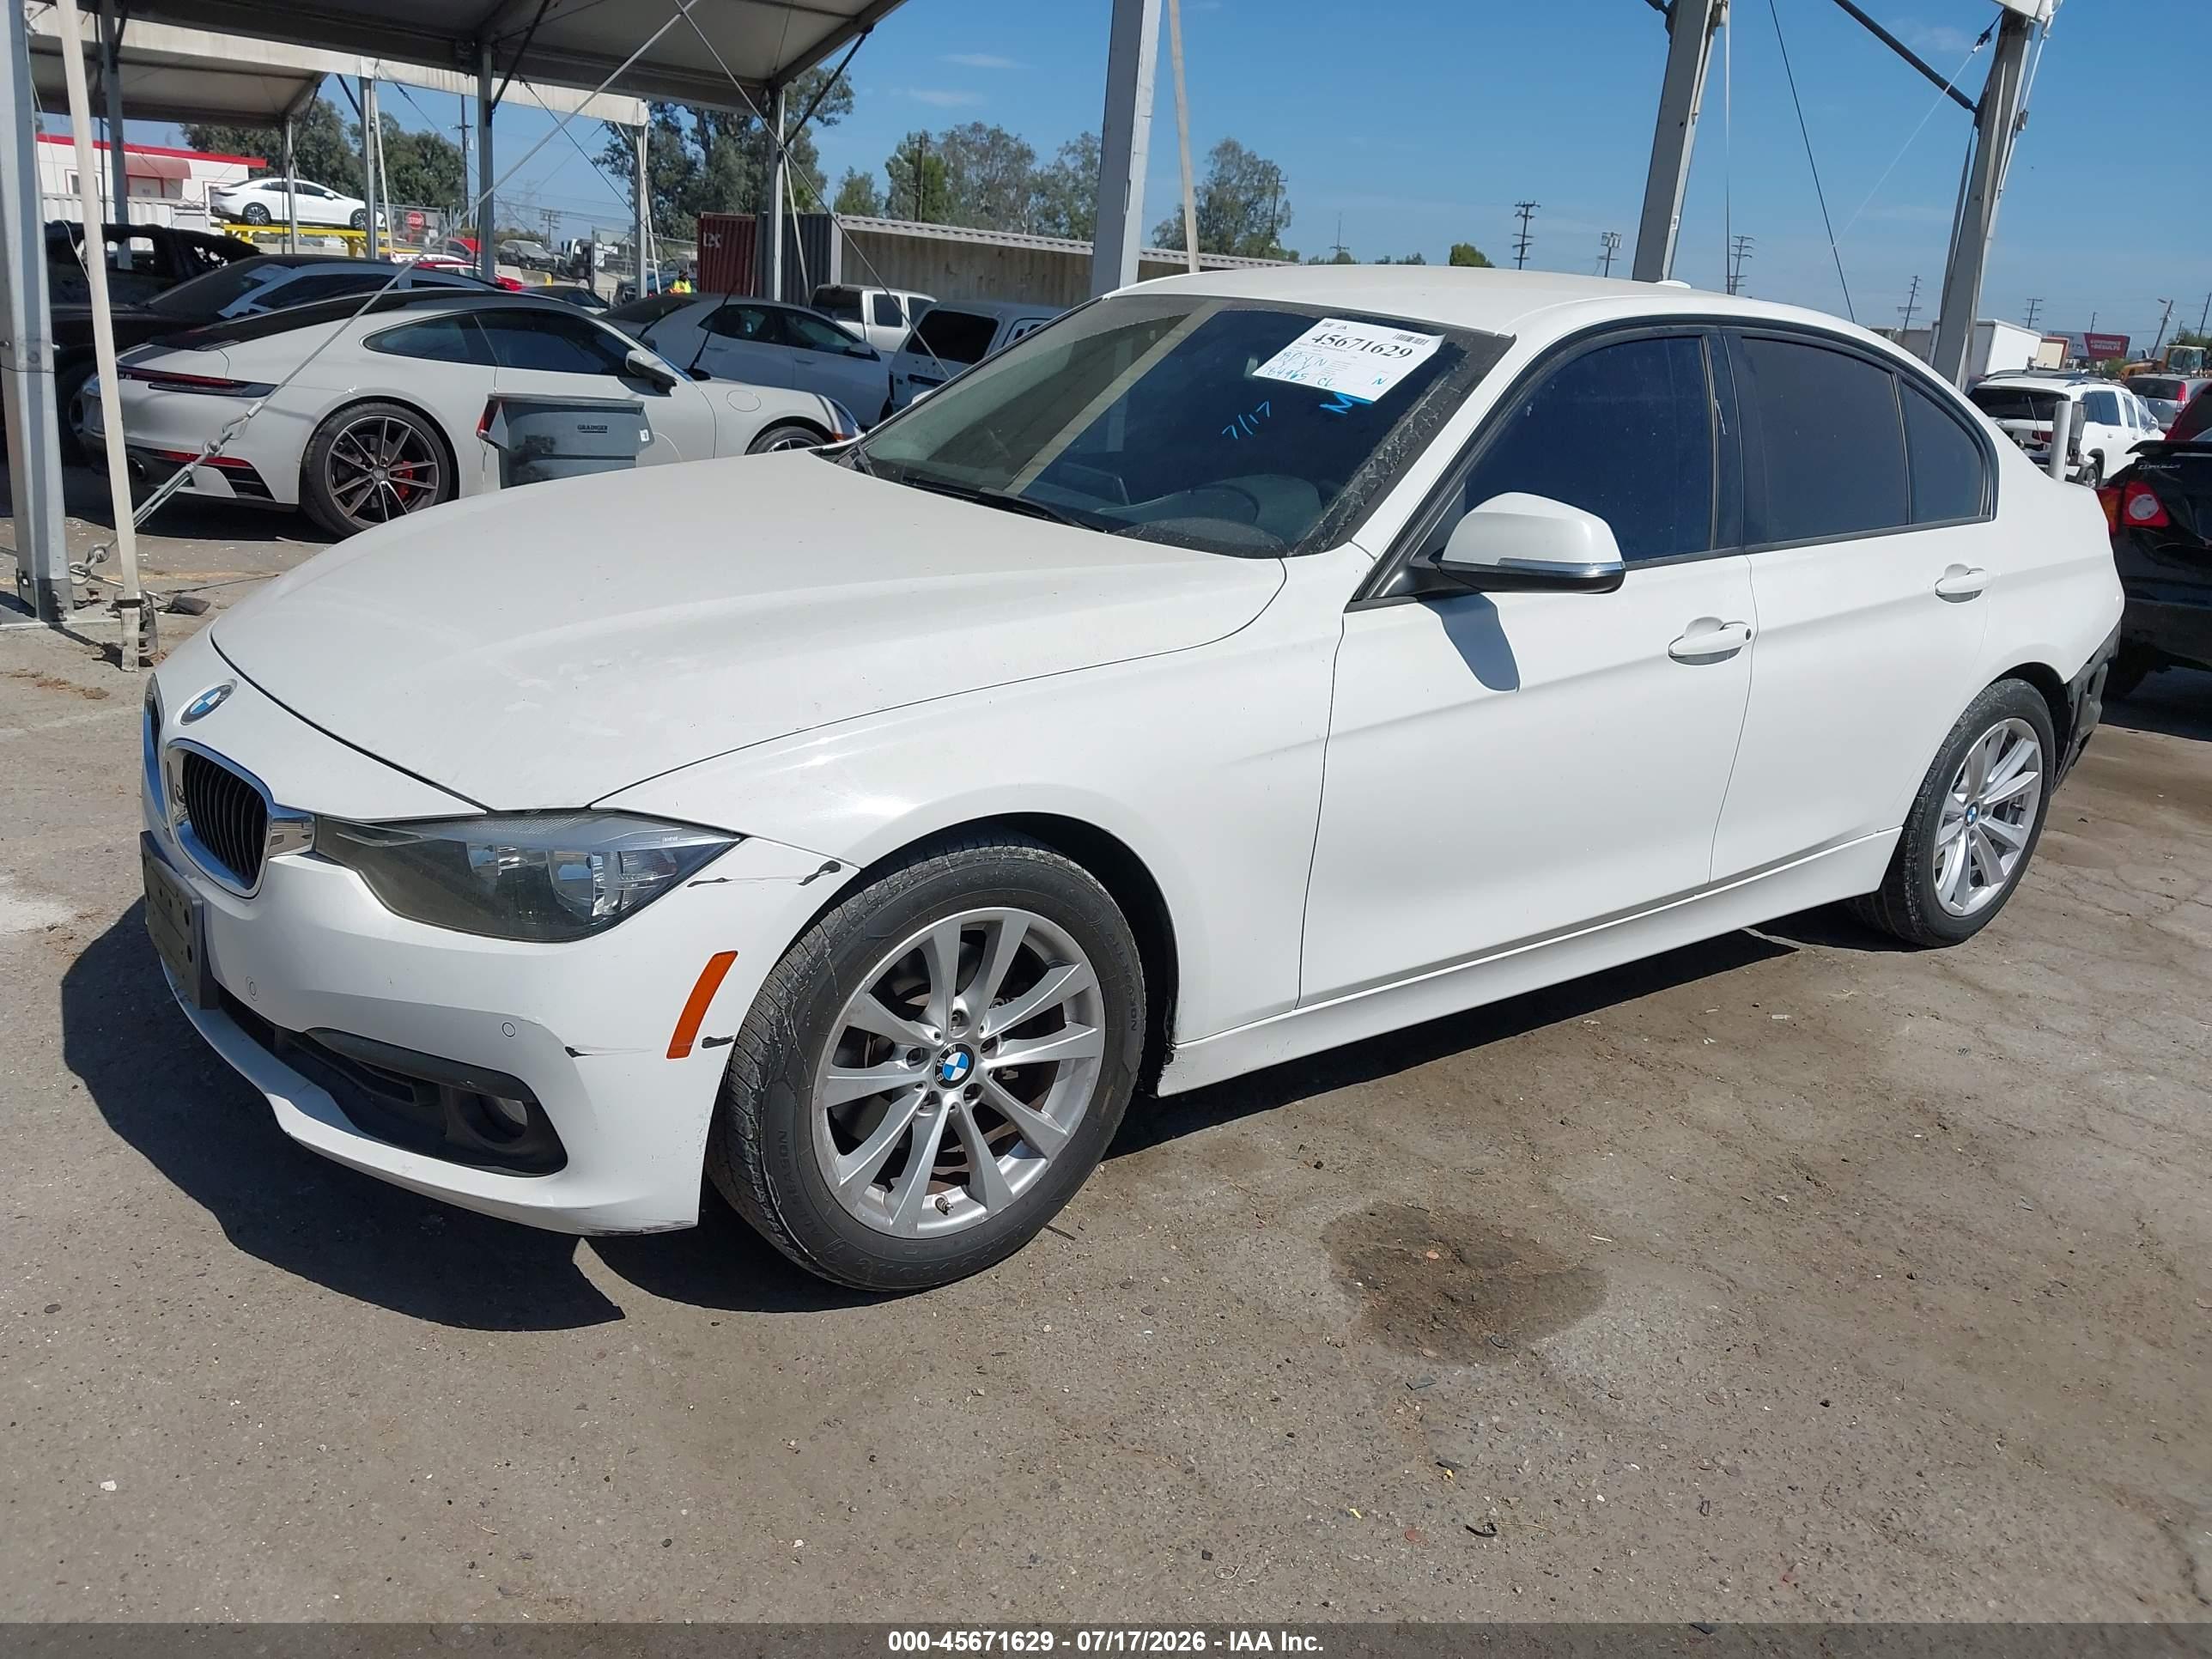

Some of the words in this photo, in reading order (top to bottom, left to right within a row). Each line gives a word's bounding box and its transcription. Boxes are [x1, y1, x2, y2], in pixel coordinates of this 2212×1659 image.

[407, 216, 422, 225] STOP
[1311, 332, 1413, 359] 45671629
[1221, 399, 1271, 440] 7/17
[936, 1044, 957, 1082] BMW
